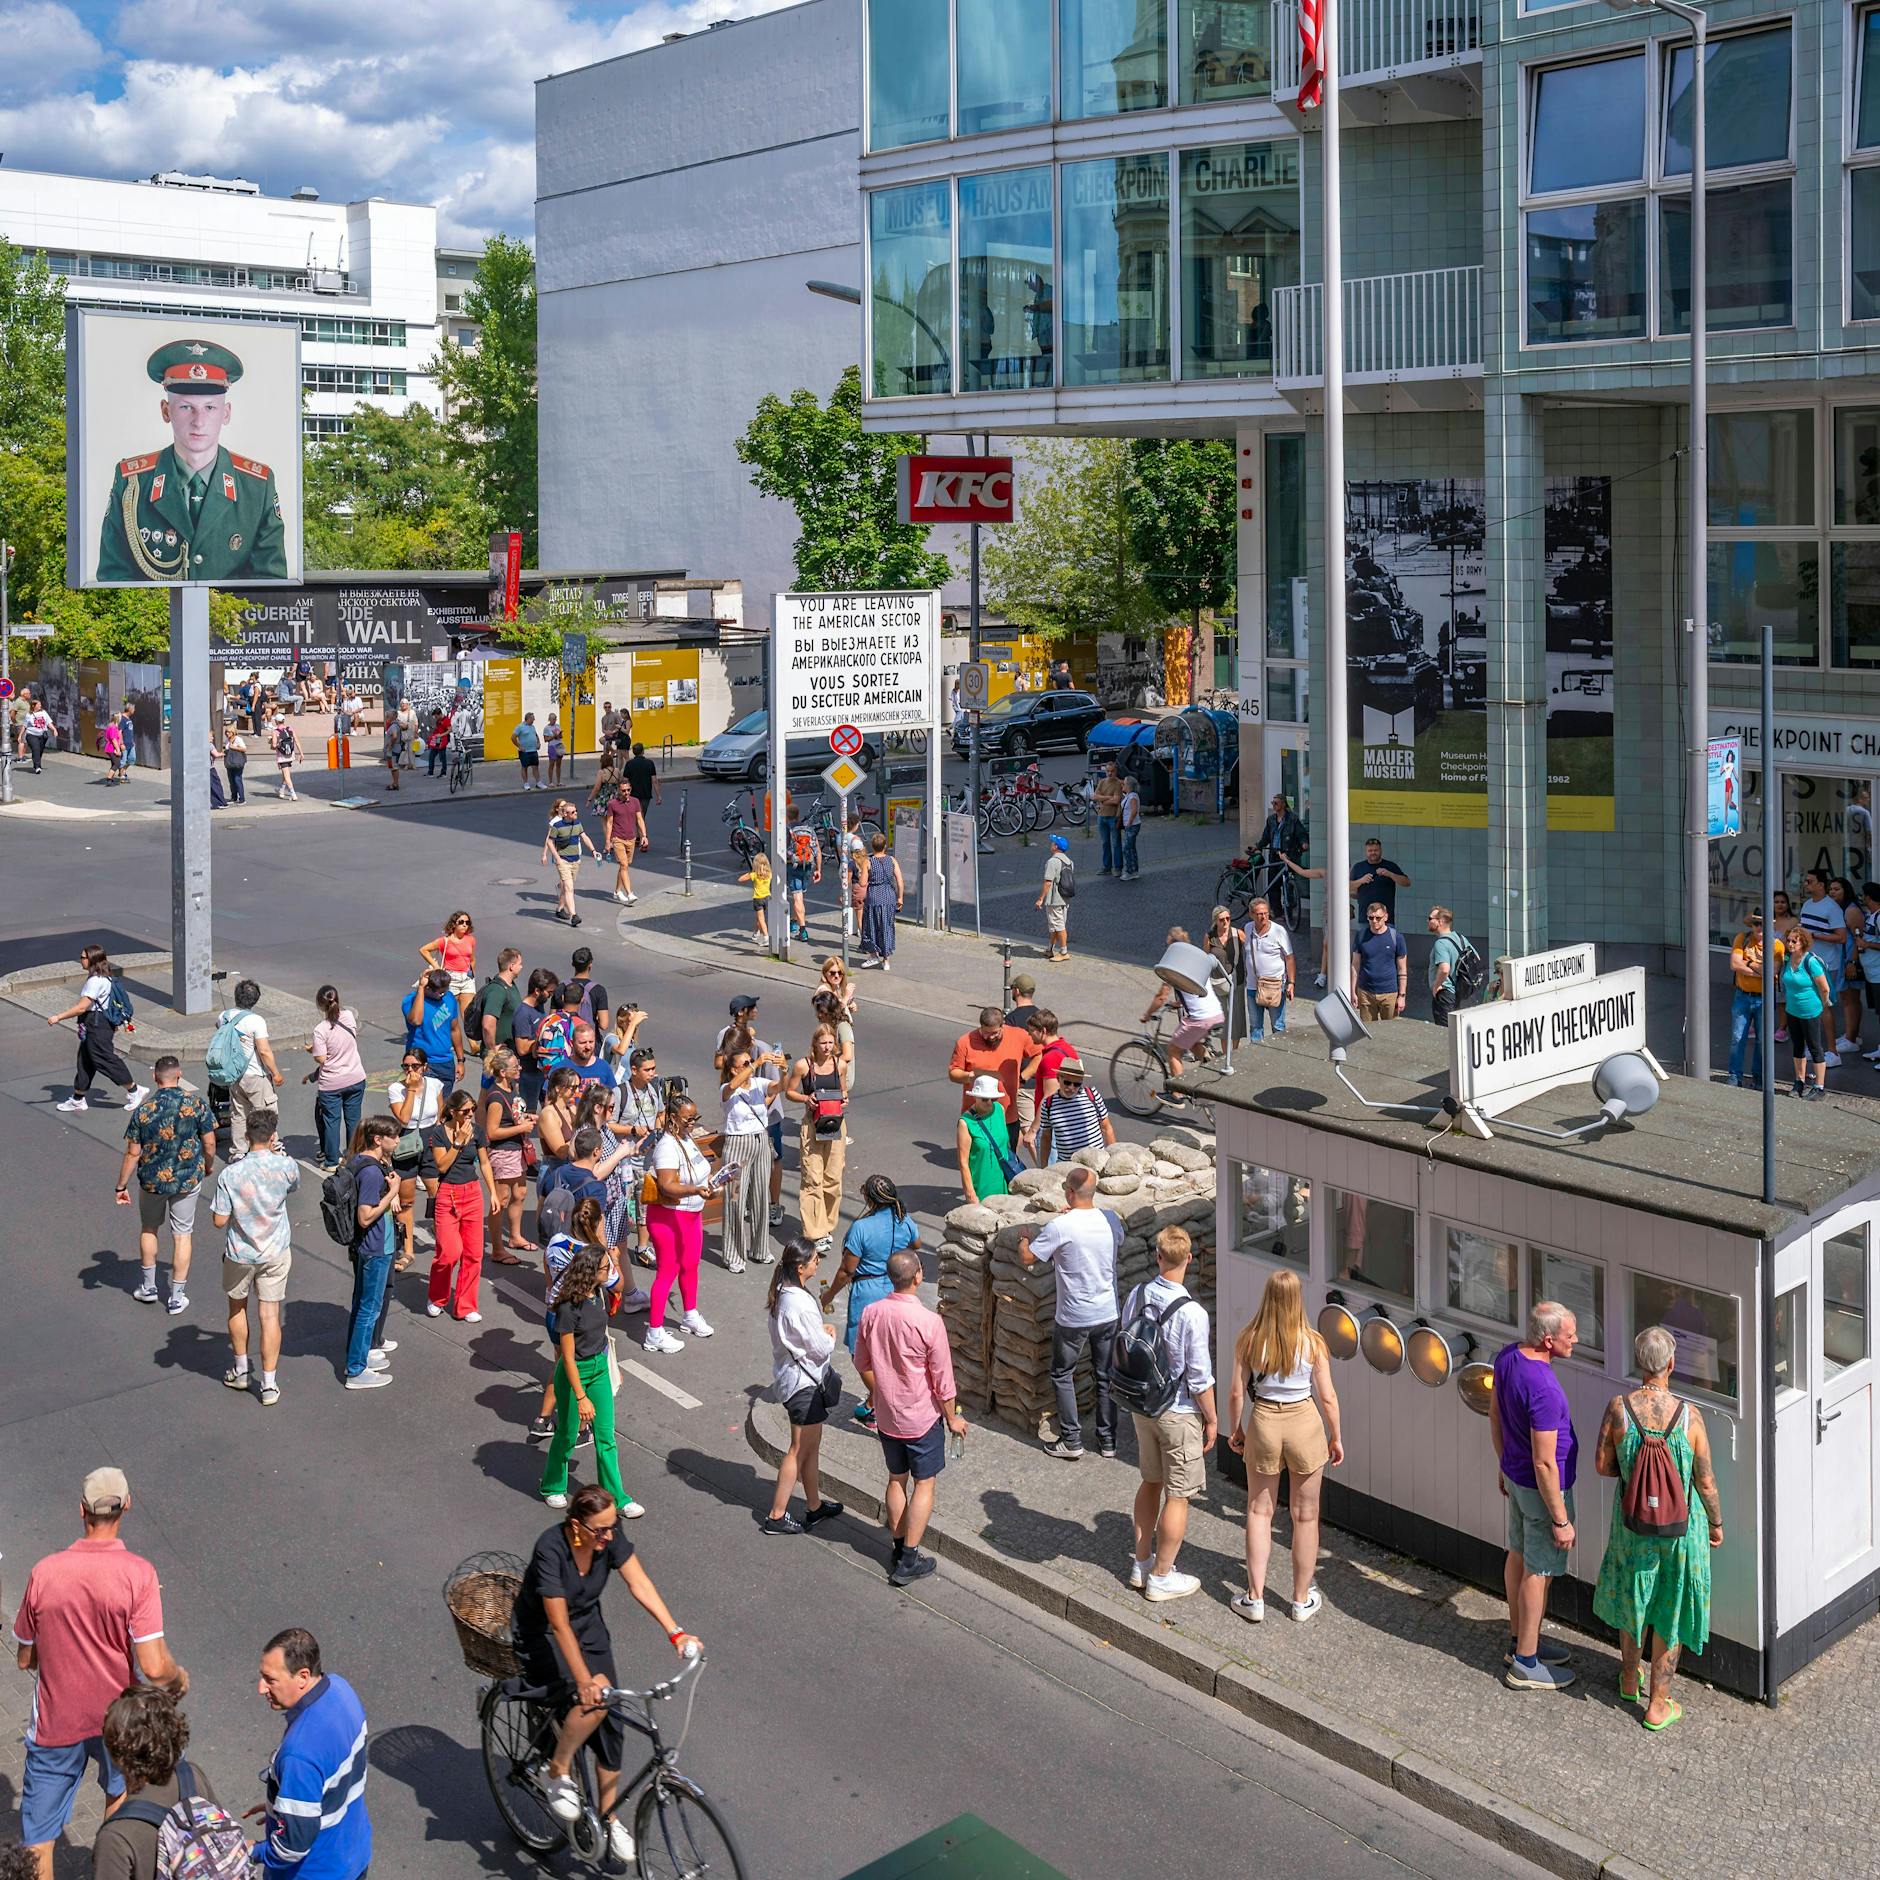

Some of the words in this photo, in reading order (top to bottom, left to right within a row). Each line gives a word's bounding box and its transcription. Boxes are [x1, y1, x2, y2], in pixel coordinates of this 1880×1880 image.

[973, 181, 1021, 217] HAUS
[1073, 164, 1168, 205] CHECKPOIN
[1194, 152, 1298, 193] CHARLIE
[914, 471, 1012, 509] KFC
[427, 606, 476, 616] EXHIBITION
[800, 598, 825, 612] YOU
[833, 597, 857, 611] ARE
[865, 595, 914, 610] LEAVING
[244, 606, 310, 621] GUERRE
[793, 616, 812, 630] THE
[818, 614, 875, 629] AMERICAN
[881, 612, 921, 627] SECTOR
[345, 620, 422, 644] WALL
[245, 647, 270, 655] KALTER
[271, 647, 292, 655] KRIEG
[795, 639, 814, 653] ВЫ
[822, 635, 896, 651] ВЫЕЗЖАЕТЕ
[904, 634, 919, 648] ИЗ
[791, 653, 876, 670] АМЕРИКАНСКОГО
[880, 651, 922, 666] СЕКТОРА
[810, 675, 845, 690] VOUS
[852, 672, 899, 688] SORTEZ
[968, 674, 980, 688] 30
[792, 695, 807, 710] DU
[811, 693, 860, 708] SECTEUR
[864, 688, 922, 707] AMÉRICAIN
[1241, 698, 1260, 716] 45
[792, 717, 802, 728] SIE
[803, 714, 836, 727] VERLASSEN
[837, 713, 849, 725] DEN
[850, 711, 900, 724] AMERIKANISCHEN
[901, 709, 922, 720] SEKTOR
[1707, 741, 1738, 751] DESTINATION
[1724, 725, 1843, 753] CHEKPOINT
[1851, 734, 1880, 756] CH
[1363, 749, 1415, 766] MAUER
[1440, 751, 1478, 760] Museum
[1363, 766, 1415, 780] MUSEUM
[1440, 773, 1467, 782] Home
[1468, 774, 1479, 782] of
[1547, 775, 1570, 784] 1962
[1524, 959, 1546, 987] ALLIED
[1547, 953, 1586, 981] CHECKPOINT
[1502, 1015, 1545, 1061] ARMY
[1551, 991, 1636, 1048] CHECKPOINT
